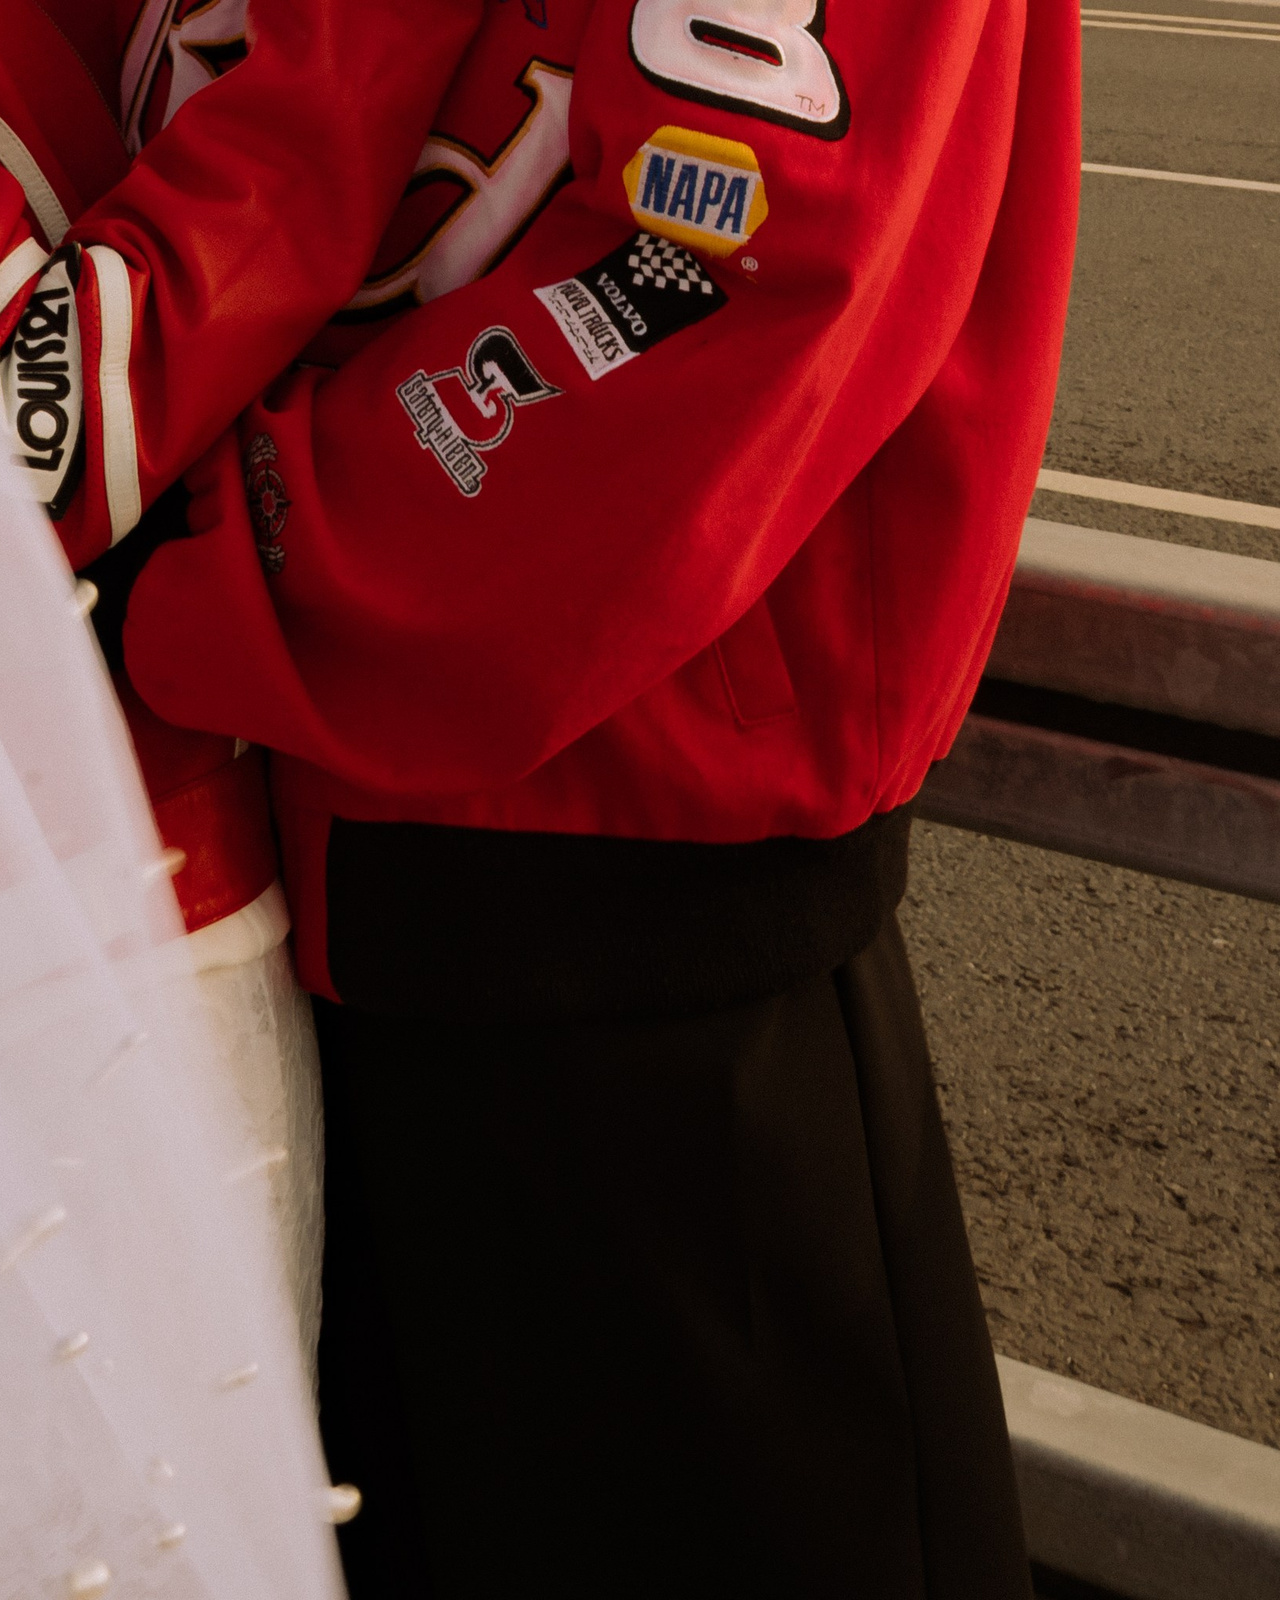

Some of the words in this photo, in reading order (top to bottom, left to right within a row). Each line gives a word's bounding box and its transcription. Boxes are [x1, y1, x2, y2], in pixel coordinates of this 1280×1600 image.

[641, 154, 748, 234] NAPA
[577, 307, 624, 362] TRUCKS
[596, 272, 648, 336] VOLVO
